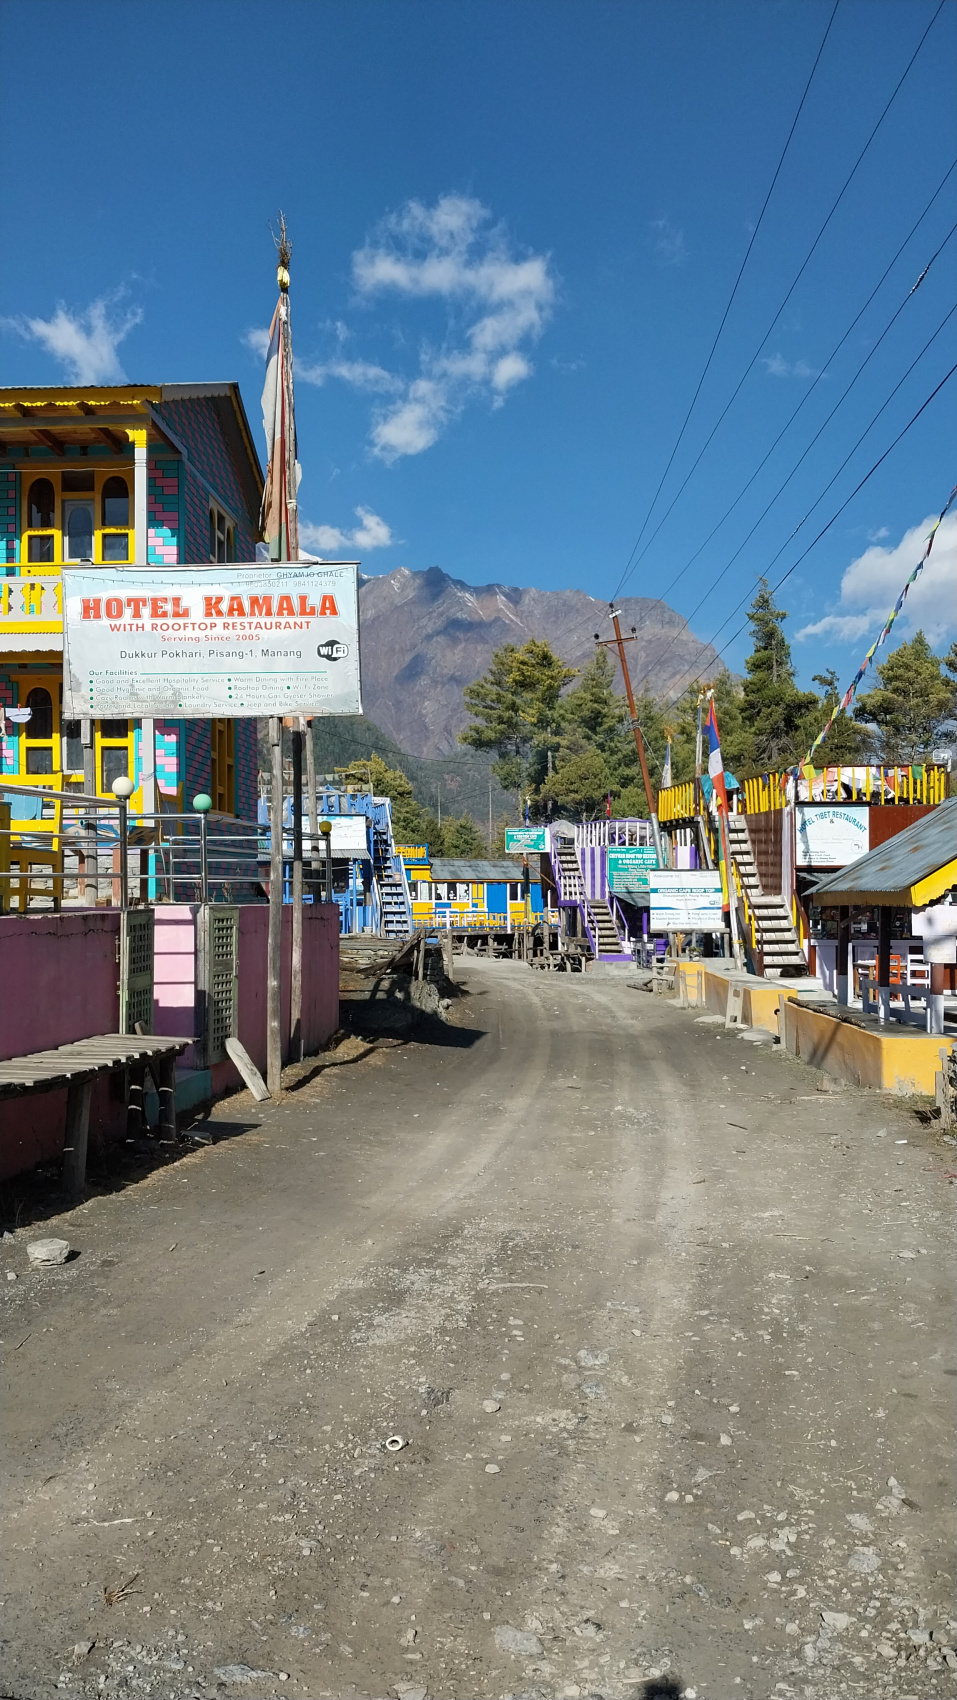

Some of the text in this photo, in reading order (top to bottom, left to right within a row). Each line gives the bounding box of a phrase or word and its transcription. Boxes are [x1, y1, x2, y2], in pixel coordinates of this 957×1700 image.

[81, 594, 339, 620] HOTEL KAMALA
[109, 620, 312, 632] WITH ROOFTOP RESTAURANT
[161, 635, 200, 643] Serving
[120, 649, 302, 659] Dukkur Pokhari, Pisang-1, Manang
[797, 811, 867, 834] HOTEL TIBET RESTAURANT
